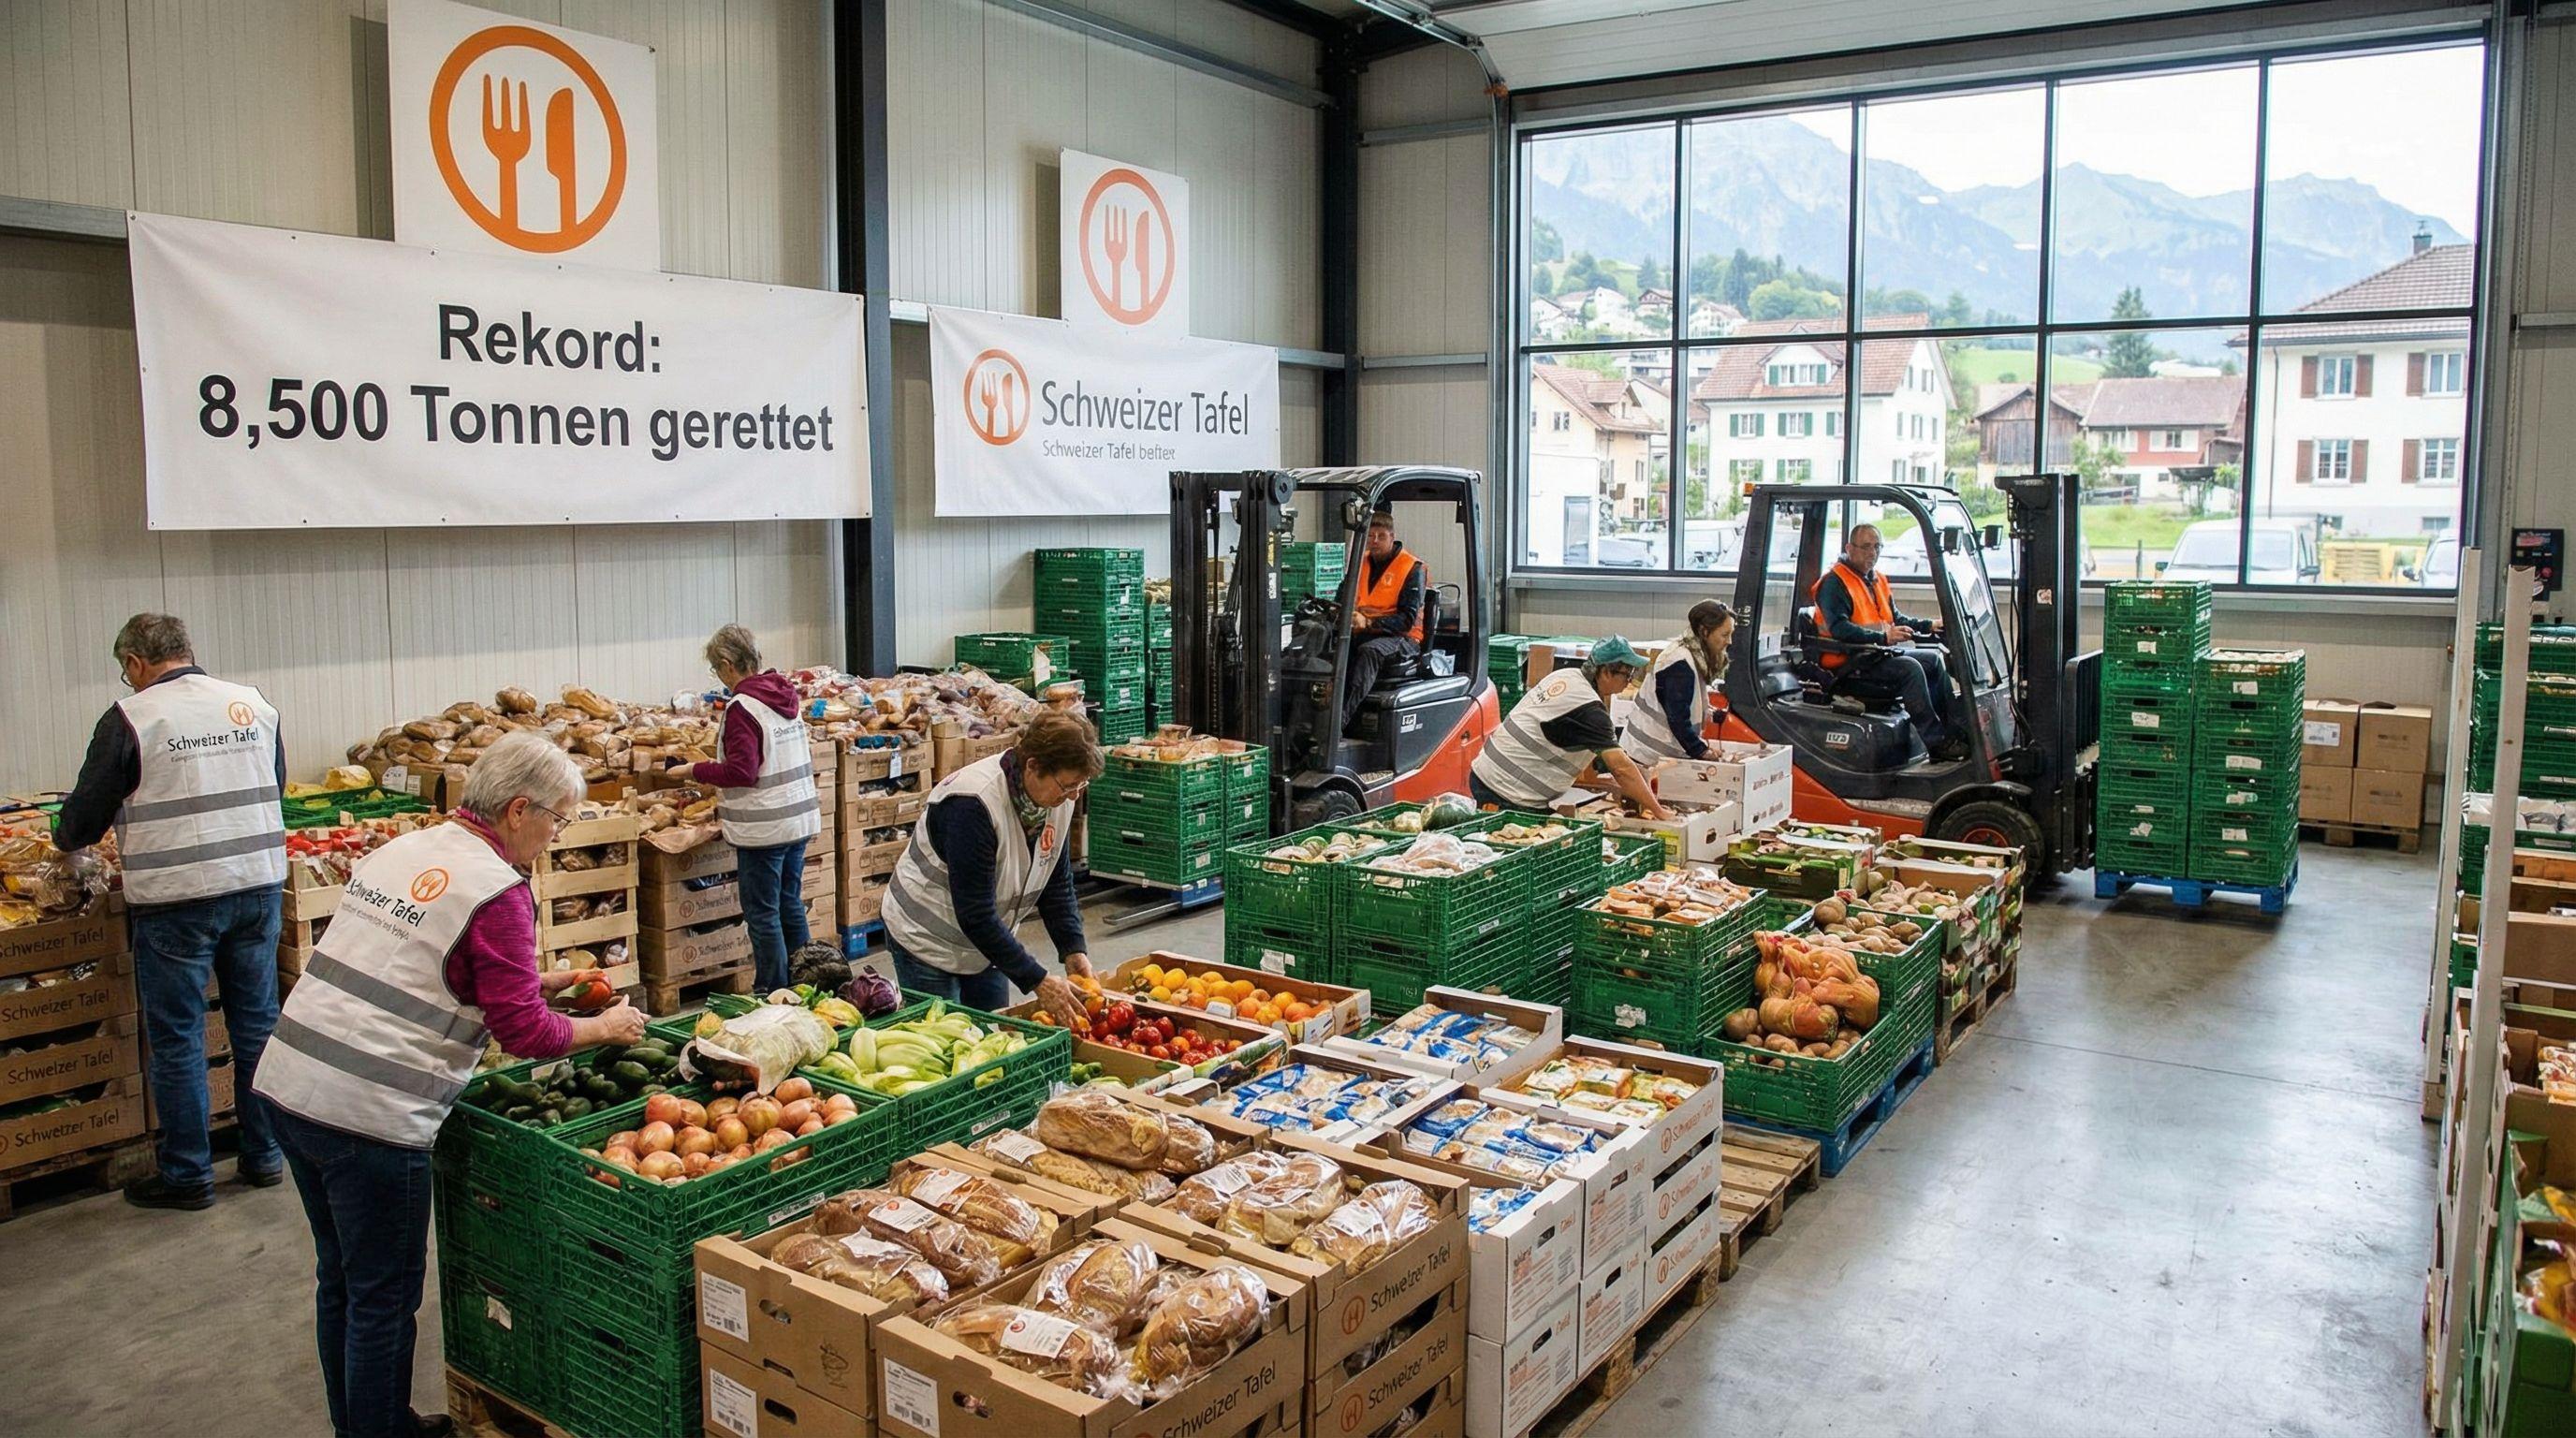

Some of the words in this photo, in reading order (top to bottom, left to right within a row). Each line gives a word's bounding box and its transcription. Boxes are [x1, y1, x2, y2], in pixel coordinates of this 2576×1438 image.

[439, 303, 662, 373] Rekord:
[198, 374, 388, 449] 8,500
[411, 384, 631, 448] Tonnen
[649, 403, 833, 462] gerettet
[1041, 380, 1184, 432] Schweizer
[1190, 390, 1249, 435] Tafel
[1043, 440, 1104, 460] Schweizer
[1106, 442, 1135, 460] Tafel
[168, 733, 229, 752] Schweizer
[232, 727, 259, 742] Tafel
[390, 898, 427, 928] Tafel
[0, 937, 66, 958] chweizer
[69, 928, 104, 946] Tafel
[1, 999, 74, 1022] Schweizer
[1243, 1360, 1276, 1398] Tafel
